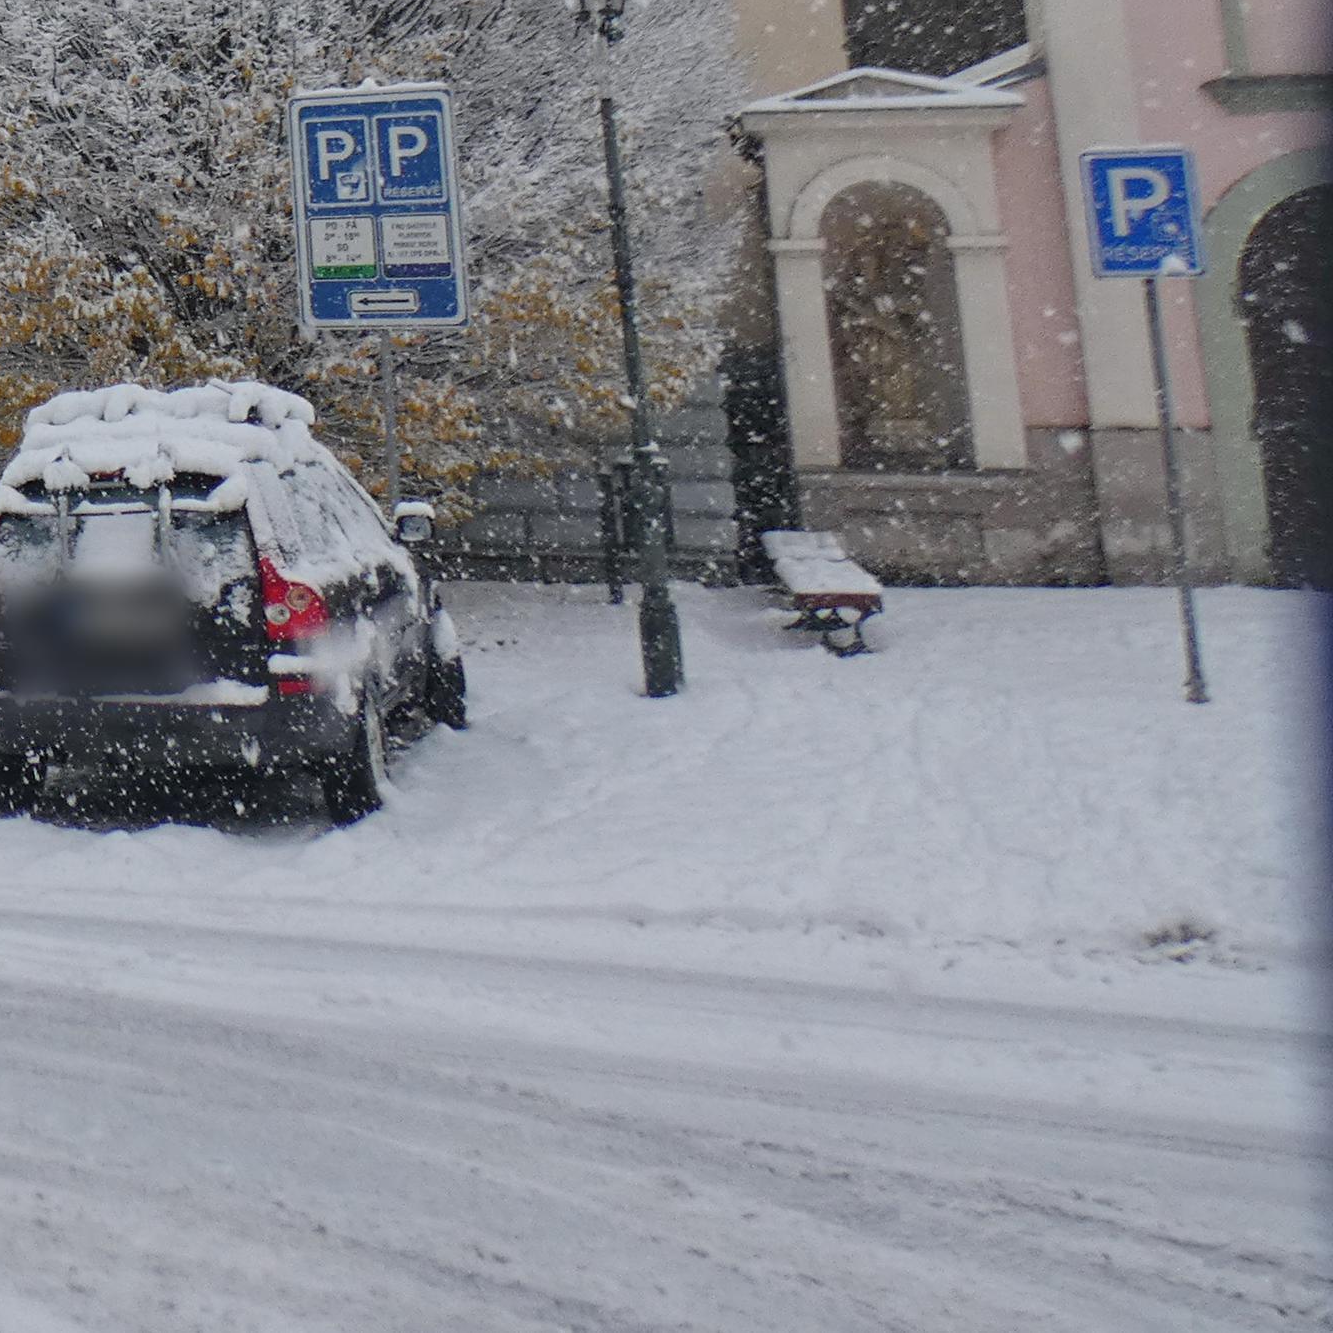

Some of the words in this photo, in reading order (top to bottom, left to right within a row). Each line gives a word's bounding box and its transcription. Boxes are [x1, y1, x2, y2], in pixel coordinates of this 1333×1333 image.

[316, 130, 355, 181] P
[388, 126, 428, 177] P
[1107, 168, 1170, 237] P
